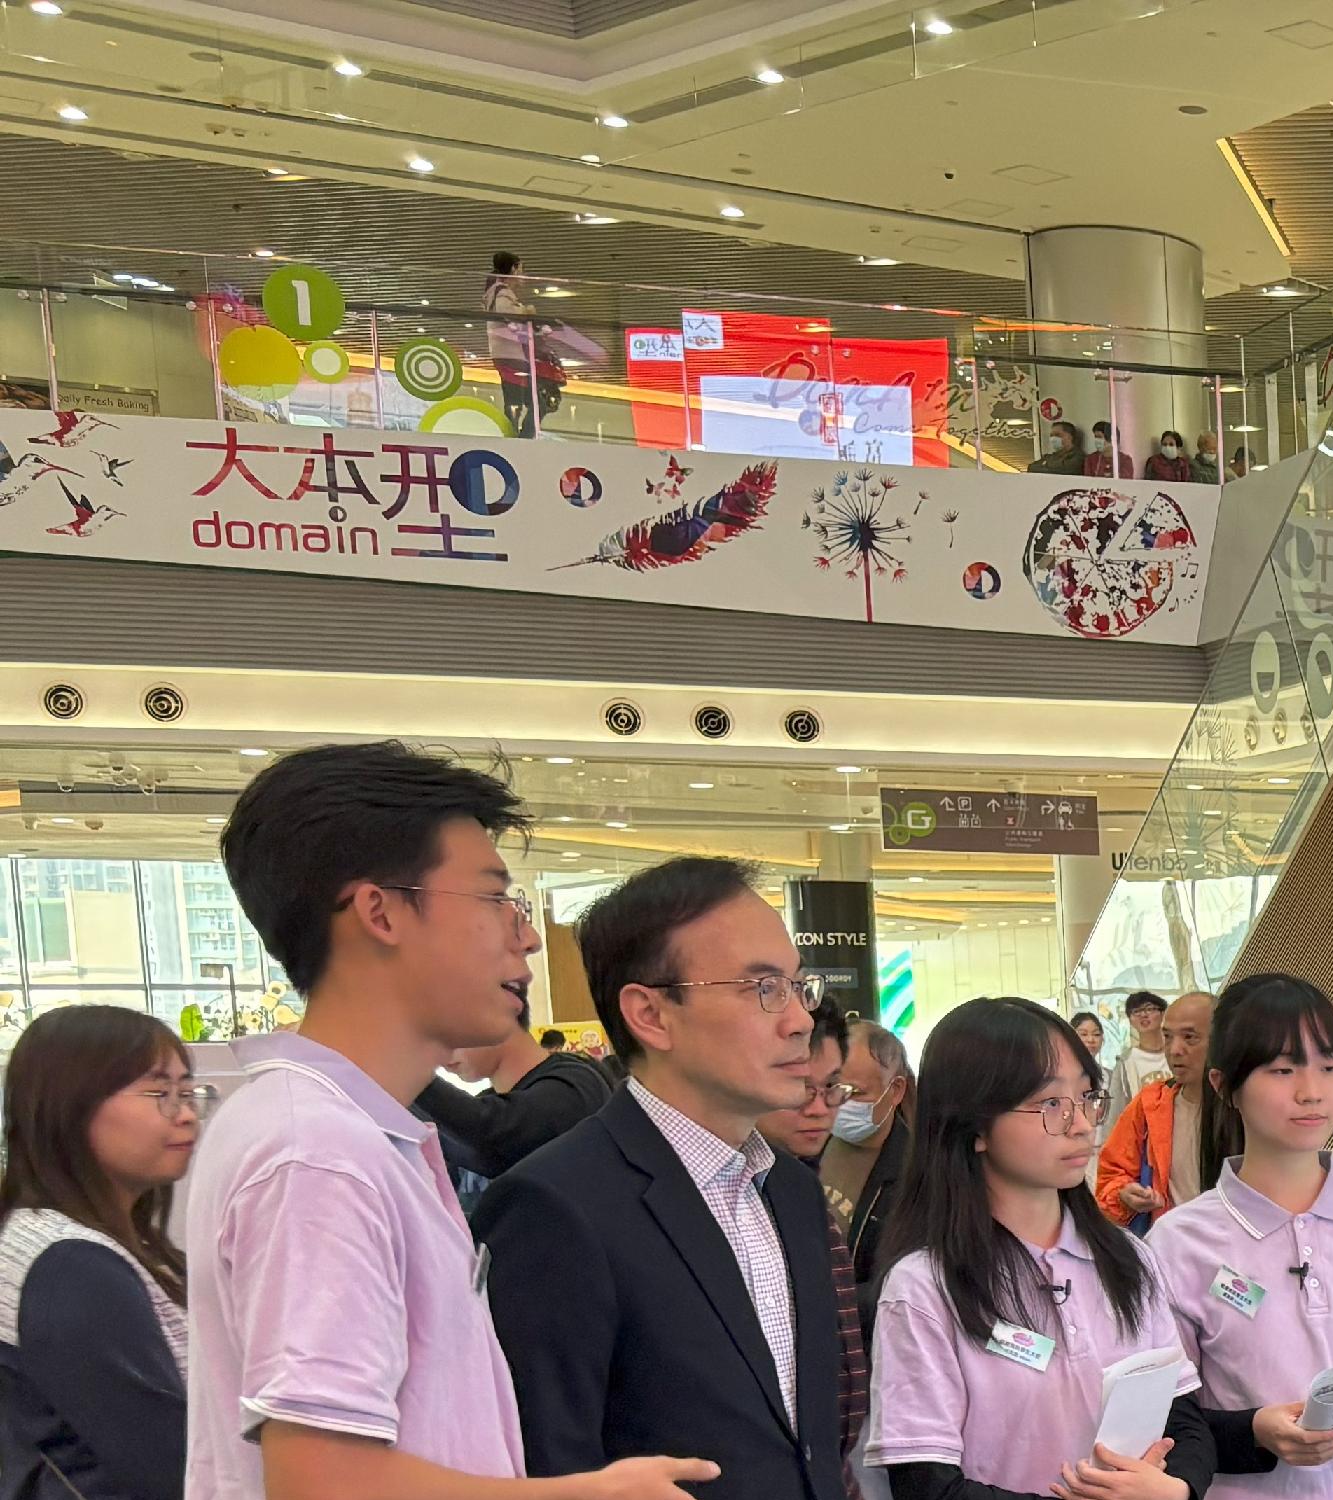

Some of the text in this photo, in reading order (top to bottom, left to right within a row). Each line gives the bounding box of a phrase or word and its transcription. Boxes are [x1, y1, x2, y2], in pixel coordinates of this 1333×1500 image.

[290, 280, 312, 326] 1
[84, 395, 114, 407] Fresh
[117, 398, 150, 412] Baking
[192, 505, 379, 556] domain
[907, 810, 932, 829] G
[827, 933, 866, 945] STYLE
